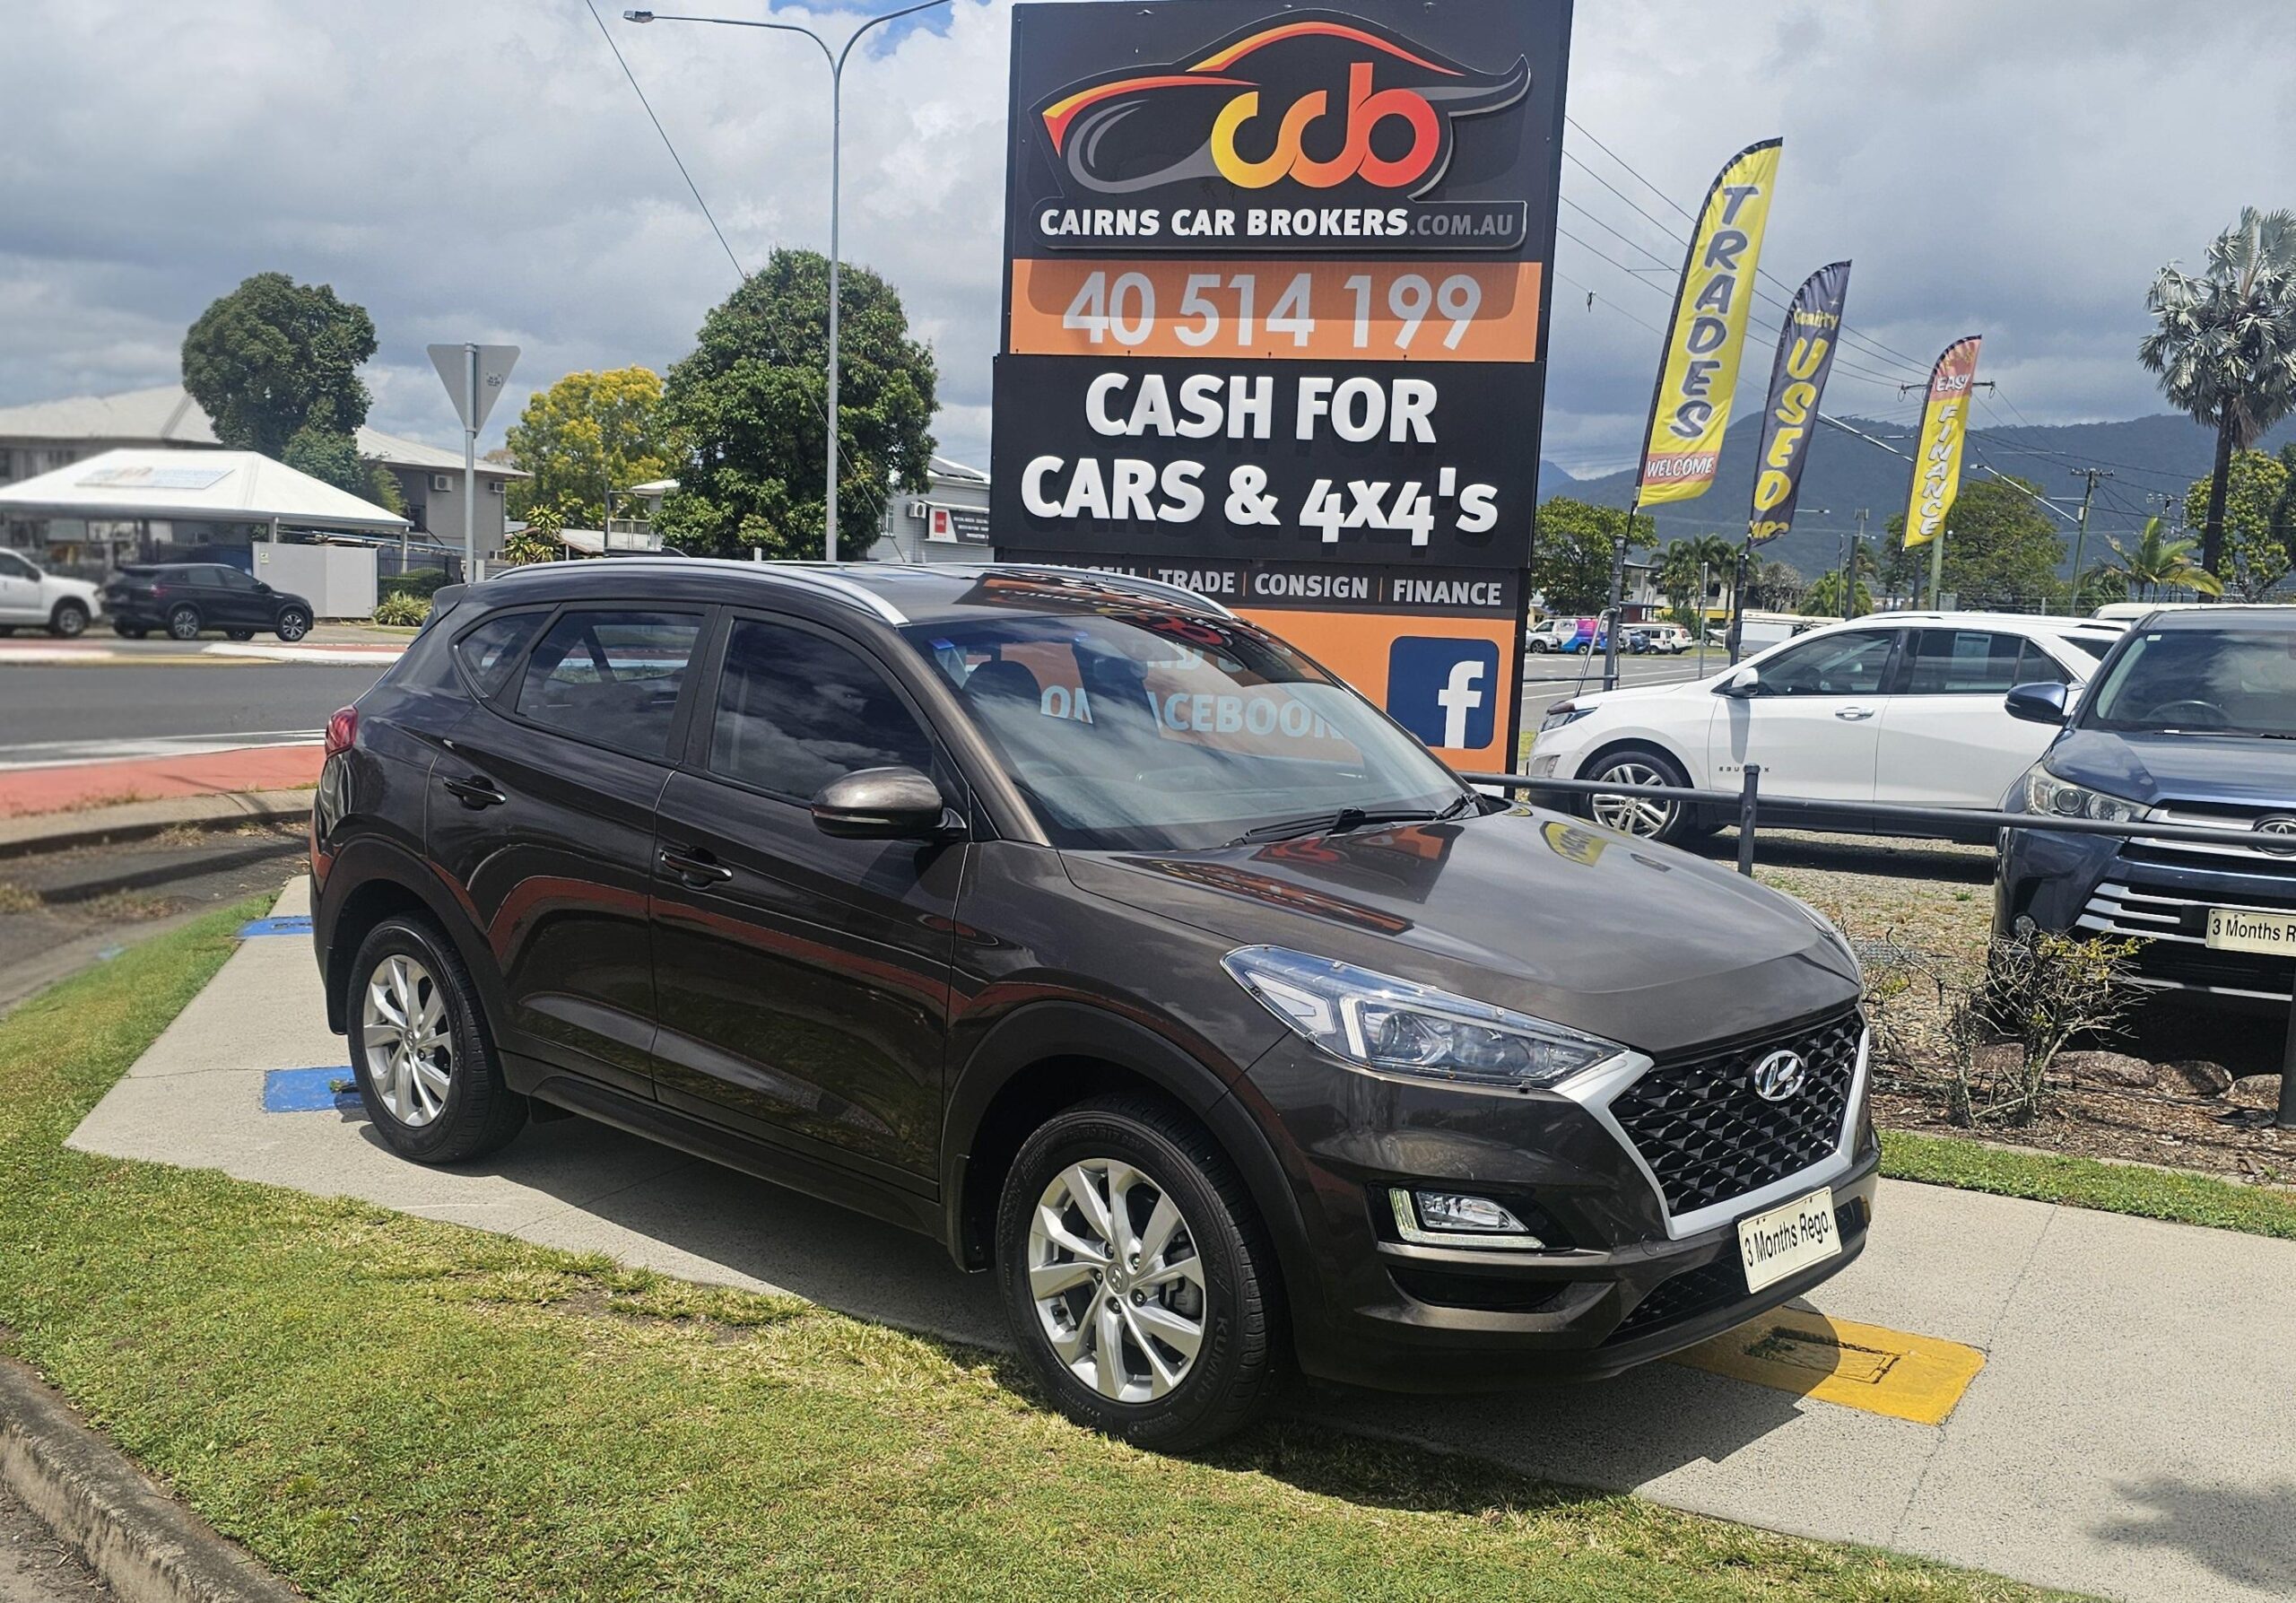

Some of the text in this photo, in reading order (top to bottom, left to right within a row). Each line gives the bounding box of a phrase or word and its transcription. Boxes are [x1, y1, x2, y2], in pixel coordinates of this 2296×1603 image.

[1039, 208, 1160, 237] CAIRNS
[1170, 209, 1235, 237] CAR
[1063, 271, 1482, 351] 40 514 199
[1669, 185, 1759, 439] TRADES
[1085, 372, 1437, 443] CASH FOR
[1752, 337, 1830, 511] USED
[1021, 456, 1205, 523] CARS
[1224, 465, 1281, 526] &
[1647, 456, 1714, 478] WELCOME
[1918, 404, 1959, 536] FINANCE
[1158, 569, 1502, 605] TRADE CONSIGN FINANCE
[1146, 691, 1344, 739] CEBOO
[2212, 918, 2221, 936] 3
[2225, 919, 2281, 941] Months
[1744, 1210, 1832, 1268] 3 Months Rego.
